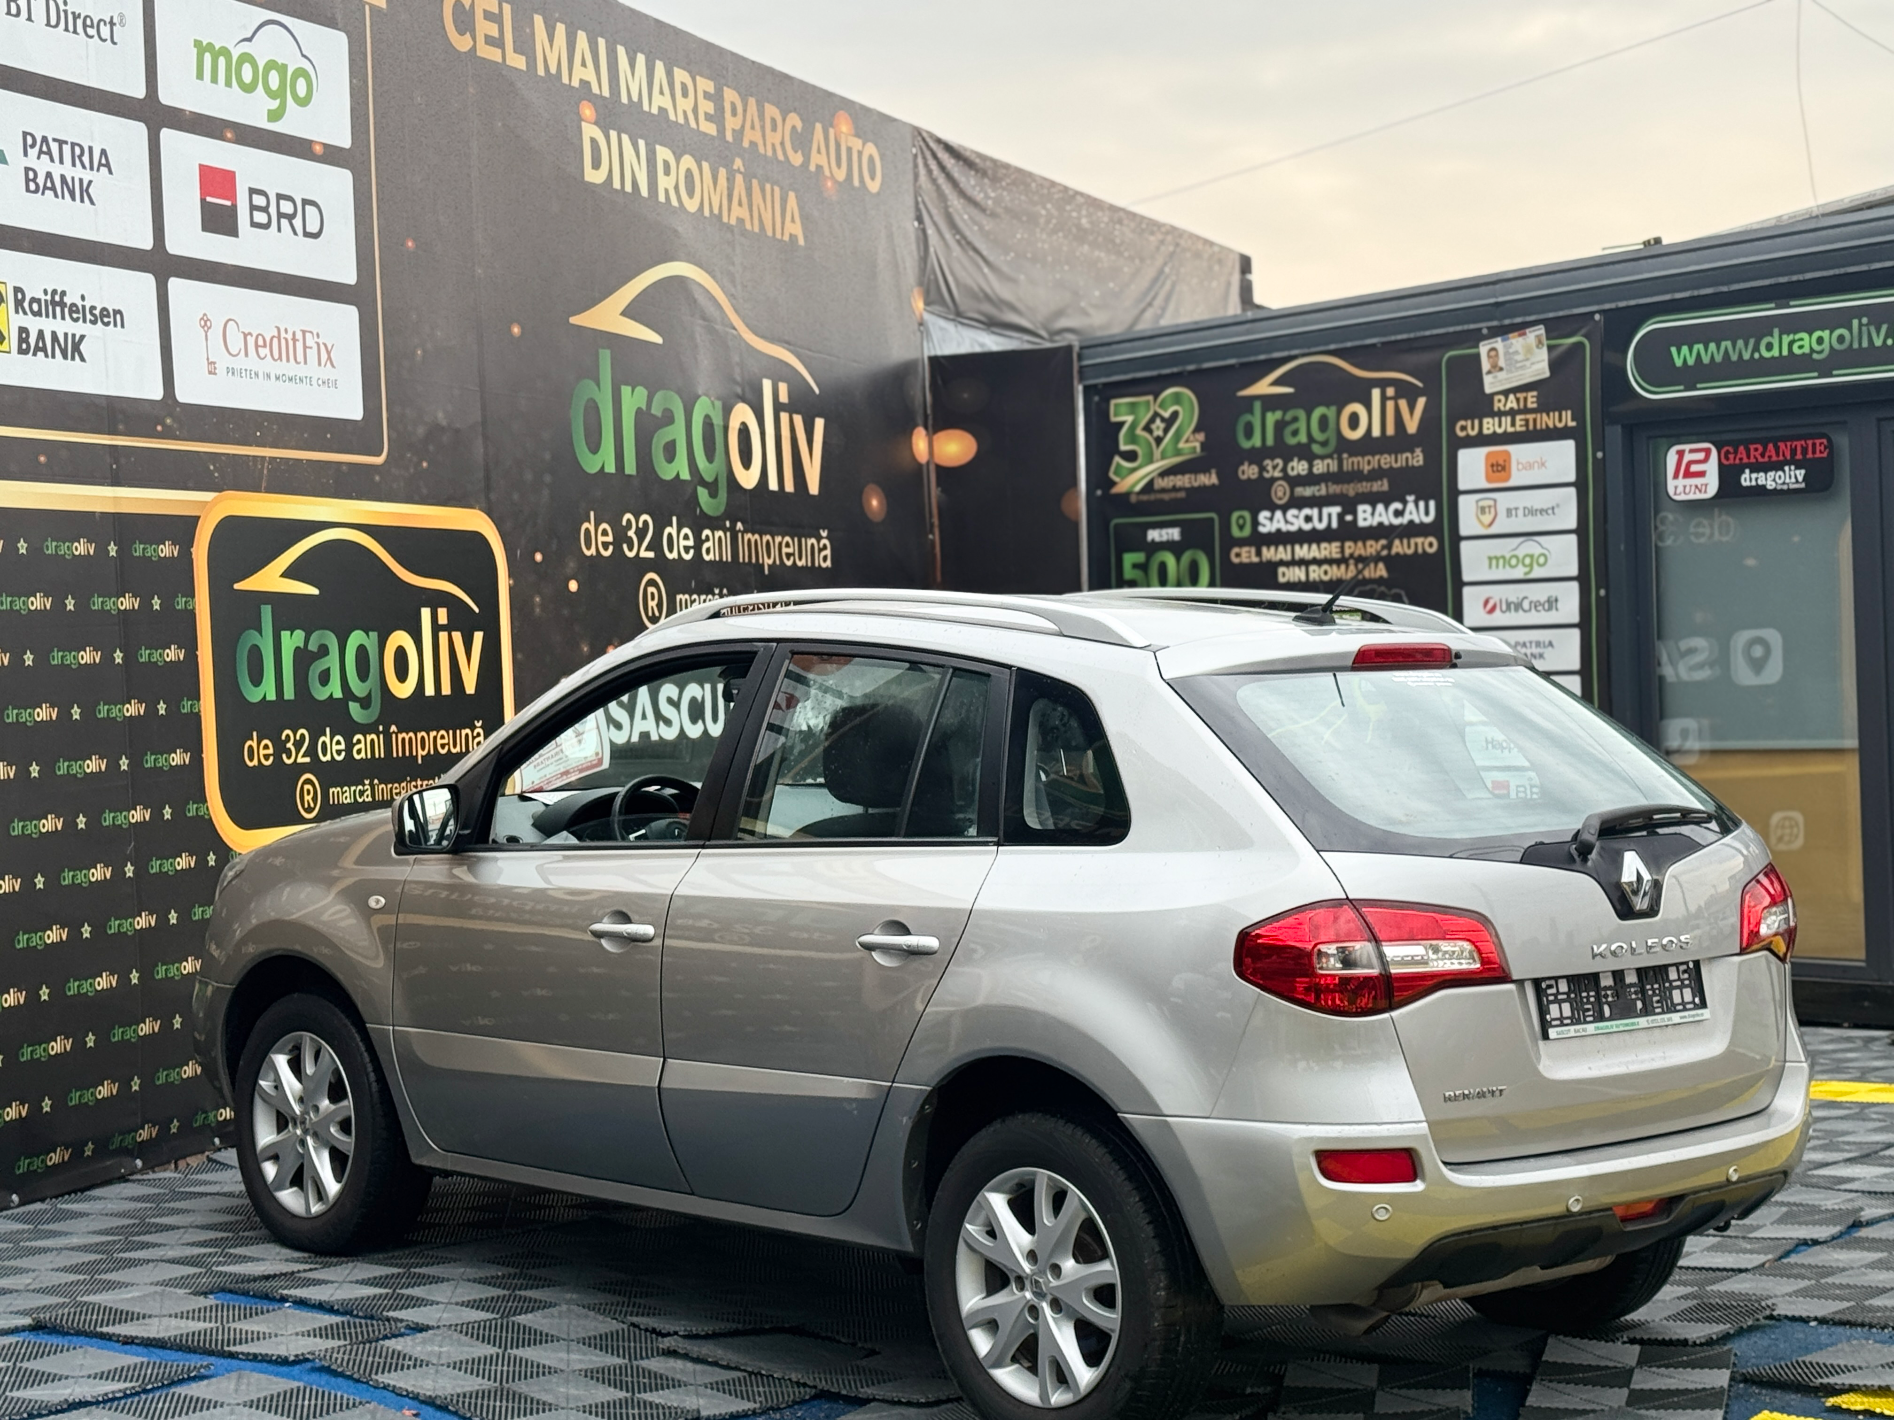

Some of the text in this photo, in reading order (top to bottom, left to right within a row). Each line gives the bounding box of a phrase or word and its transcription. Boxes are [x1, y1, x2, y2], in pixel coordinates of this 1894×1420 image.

[193, 38, 314, 122] mogo
[443, 0, 882, 194] CEL MAI MARE PARC AUTO
[22, 130, 114, 176] PATRIA
[24, 166, 96, 206] BANK
[581, 121, 805, 246] DIN ROMÂNIA
[248, 186, 325, 240] BRD
[13, 285, 126, 329] Raiffeisen
[17, 326, 87, 364] BANK
[222, 318, 337, 369] CreditFix
[226, 366, 338, 389] PRIETEN IN MOMENTE CHEIE
[1493, 391, 1538, 411] RATE
[571, 348, 825, 516] dragoliv
[1108, 386, 1201, 482] 32
[1236, 387, 1428, 456] dragoliv
[1455, 410, 1577, 437] CU BULETINUL
[1238, 447, 1424, 480] de 32 de ani împreună
[1490, 457, 1547, 474] tbi bank
[1672, 447, 1712, 480] 12
[1720, 438, 1829, 465] GARANTIE
[1673, 483, 1709, 496] LUNI
[1741, 465, 1806, 490] dragoliv
[1257, 505, 1342, 533] SASCUT
[1357, 495, 1436, 527] BACĂU
[1479, 505, 1493, 516] BT
[1506, 507, 1520, 518] BT
[44, 538, 179, 560] dragoliv dragoliv
[580, 511, 832, 575] de 32 de ani împreună
[1146, 527, 1181, 542] PESTE
[1230, 536, 1438, 564] CEL MAI MARE PARC AUTO
[1122, 548, 1210, 588] 500
[1277, 565, 1307, 583] DIN
[1487, 553, 1548, 576] mogo
[0, 592, 140, 615] dragoliv dragoliv
[1499, 595, 1559, 614] UniCredit
[50, 645, 185, 668] dragoliv dragoliv
[1515, 640, 1554, 650] PATRIA
[236, 604, 485, 724] dragoliv
[4, 699, 145, 726] dragoliv dragoliv
[608, 683, 735, 744] SASCU
[244, 720, 485, 767] de 32 de ani împreună
[55, 749, 191, 777] dragoliv dragoliv
[329, 779, 372, 805] marcă
[10, 814, 63, 838] dragoliv
[101, 805, 151, 828] dragoliv
[60, 863, 112, 887] dragoliv
[149, 852, 196, 875] dragoliv
[15, 911, 156, 949] dragoliv dragoliv
[1591, 934, 1693, 960] KOLEOS
[65, 972, 118, 996] dragoliv
[154, 956, 202, 980] dragoliv
[18, 1017, 161, 1062] dragoliv dragoliv
[67, 1079, 118, 1107] dragoliv
[155, 1059, 202, 1085] dragoliv
[15, 1146, 72, 1175] dragoliv
[109, 1123, 159, 1150] dragoliv
